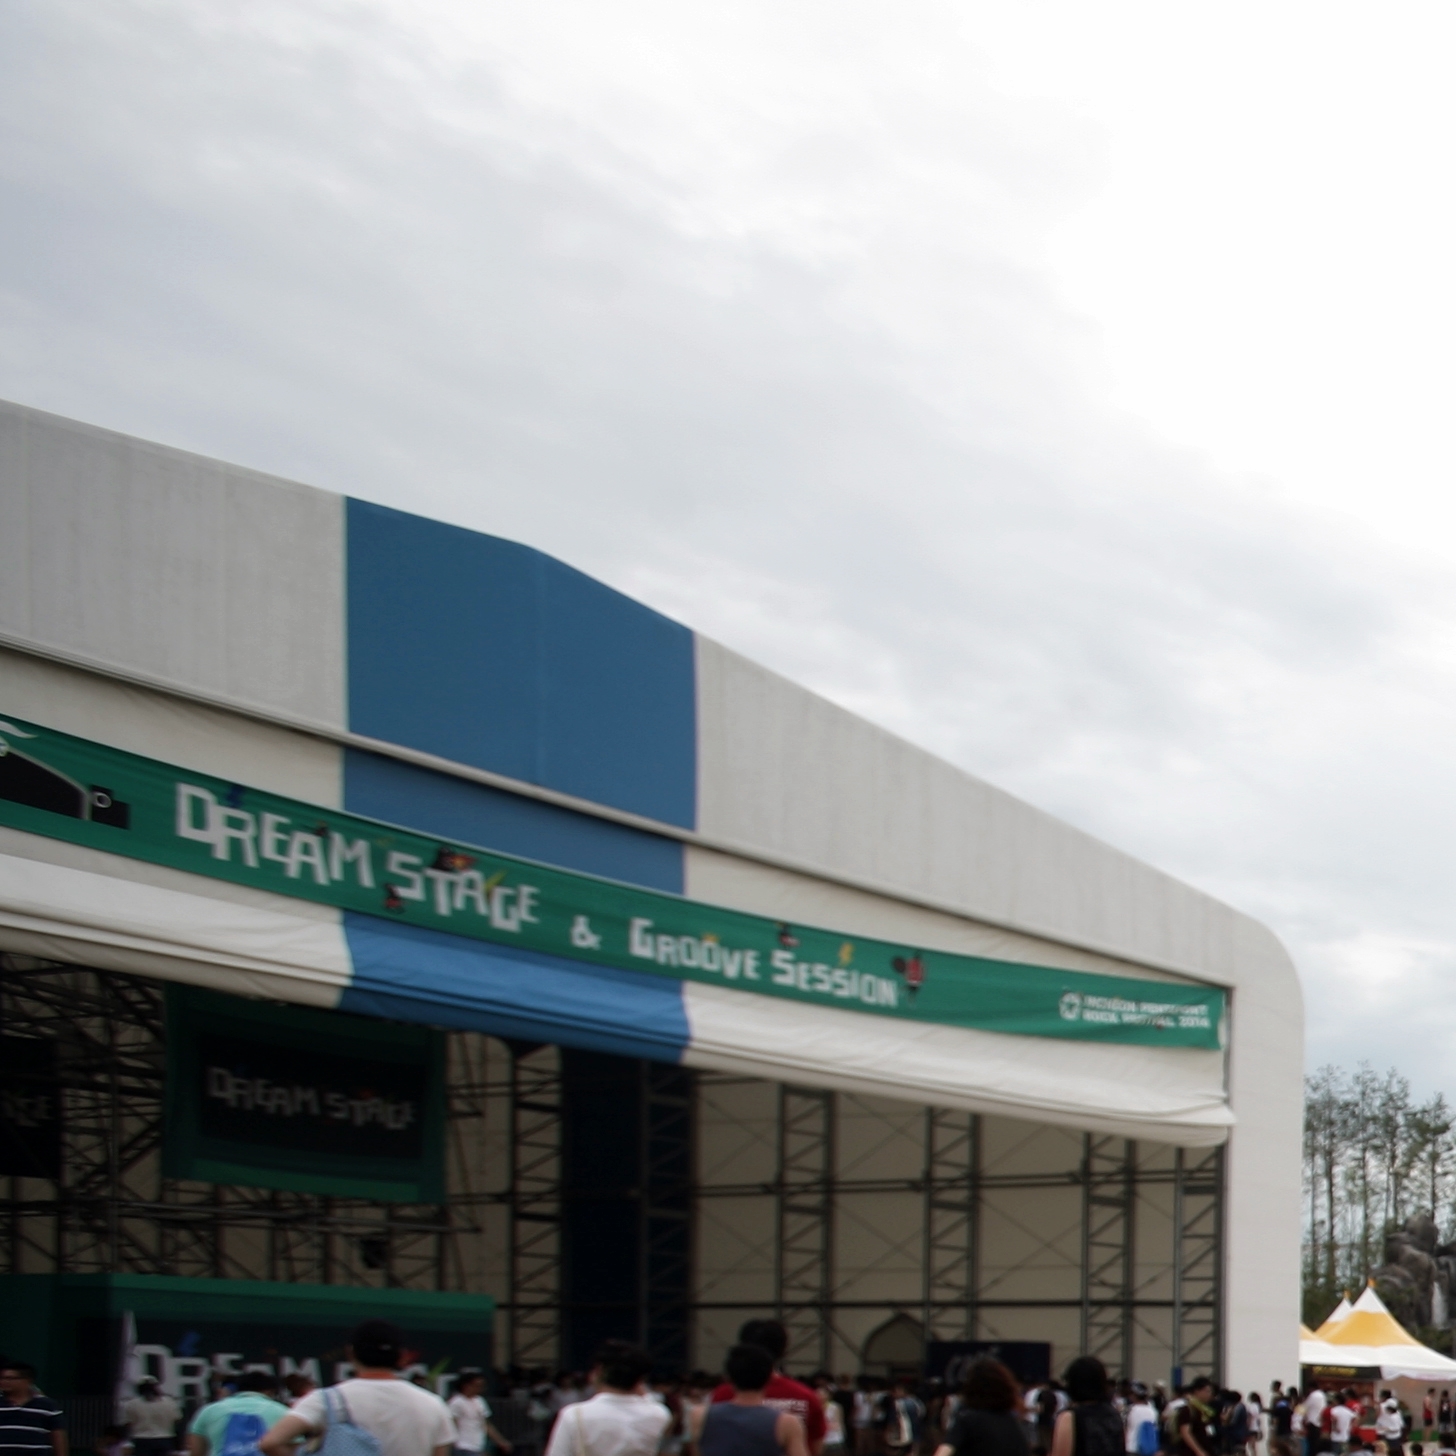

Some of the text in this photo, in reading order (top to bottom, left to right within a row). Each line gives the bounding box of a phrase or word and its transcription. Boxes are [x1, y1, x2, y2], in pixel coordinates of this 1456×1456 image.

[175, 783, 898, 1009] DREAM STAGE & GROOVE SESSION
[204, 1065, 418, 1131] DREAM STAGE
